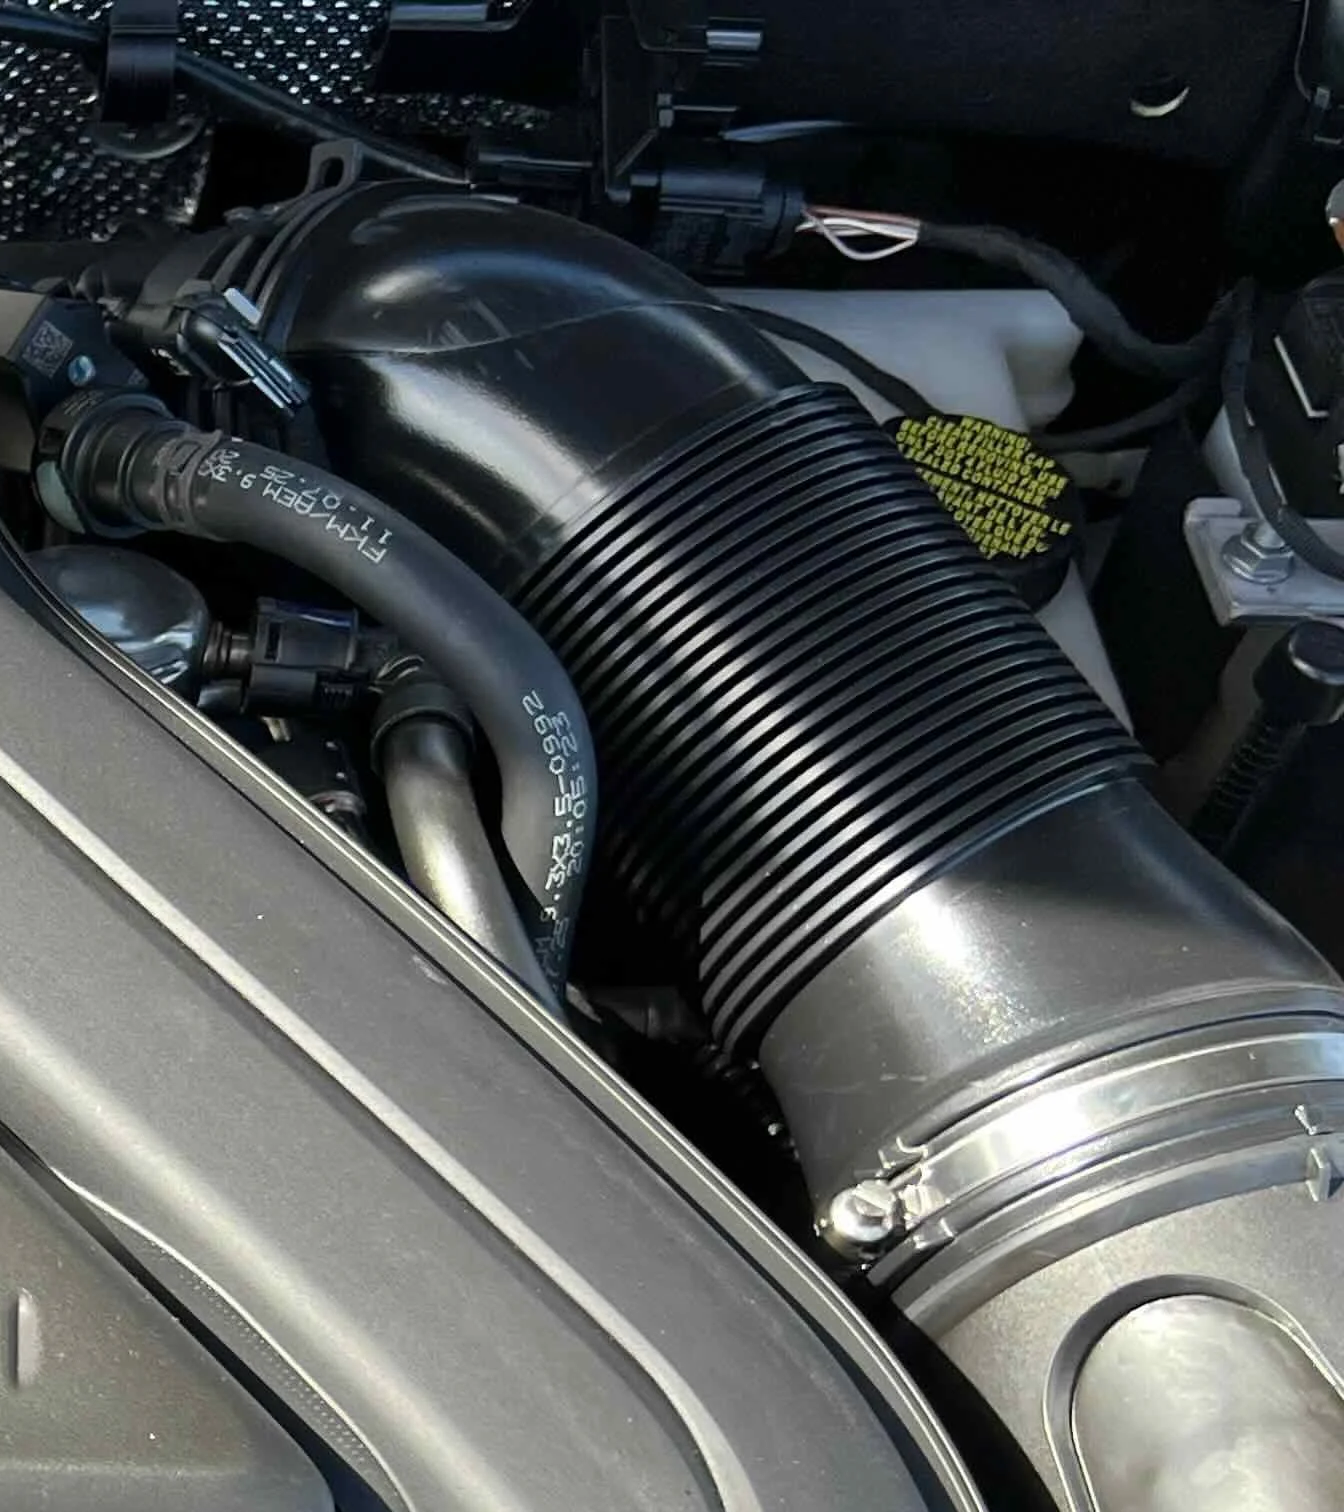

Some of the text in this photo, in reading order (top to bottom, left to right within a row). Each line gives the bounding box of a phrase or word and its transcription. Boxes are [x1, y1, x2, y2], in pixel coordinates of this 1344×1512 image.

[1025, 452, 1055, 468] CAP
[1037, 471, 1068, 489] USE
[1051, 519, 1072, 536] LE
